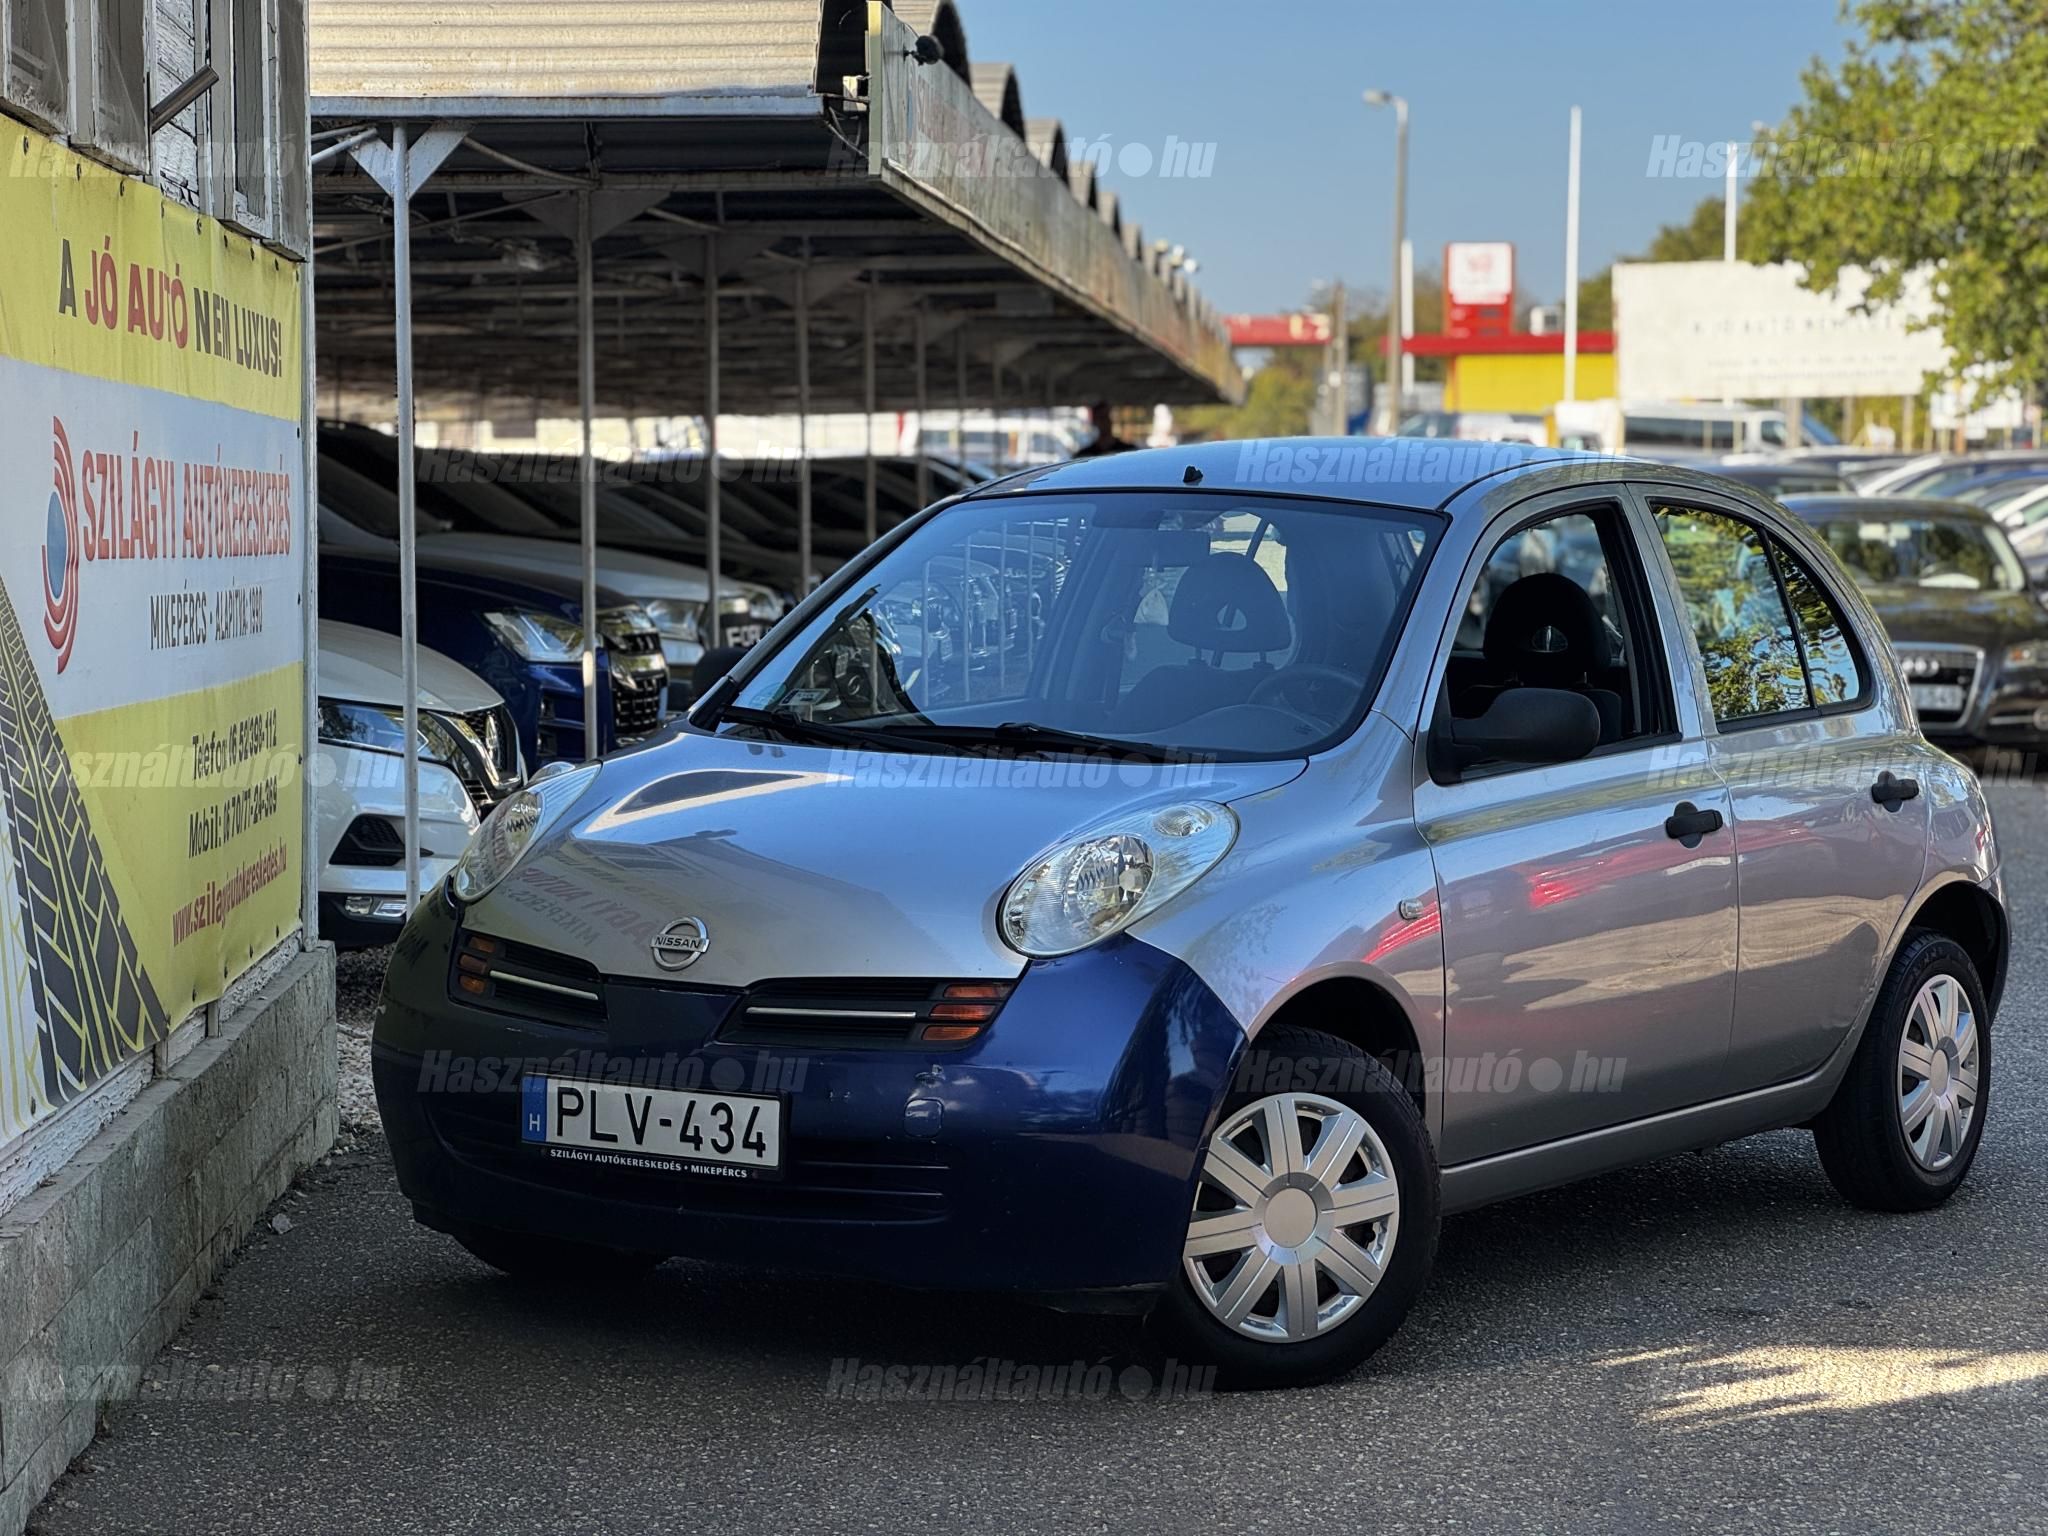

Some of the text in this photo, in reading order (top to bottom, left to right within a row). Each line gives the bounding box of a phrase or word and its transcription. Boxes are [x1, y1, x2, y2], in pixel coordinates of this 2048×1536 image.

[58, 235, 282, 377] A JÓ AUTÓ NEM LUXUS!
[81, 430, 290, 562] SZILÁGYI AUTÓKERESKEDÉS
[149, 578, 207, 651] MIKEPÉRCS
[188, 804, 222, 859] Mobil:
[655, 936, 701, 949] NISSAN
[528, 1086, 767, 1158] H PLV-434
[550, 1148, 748, 1178] SZILÁGYI AUTÓKERESKEDÉS MIKEPÉRCS
